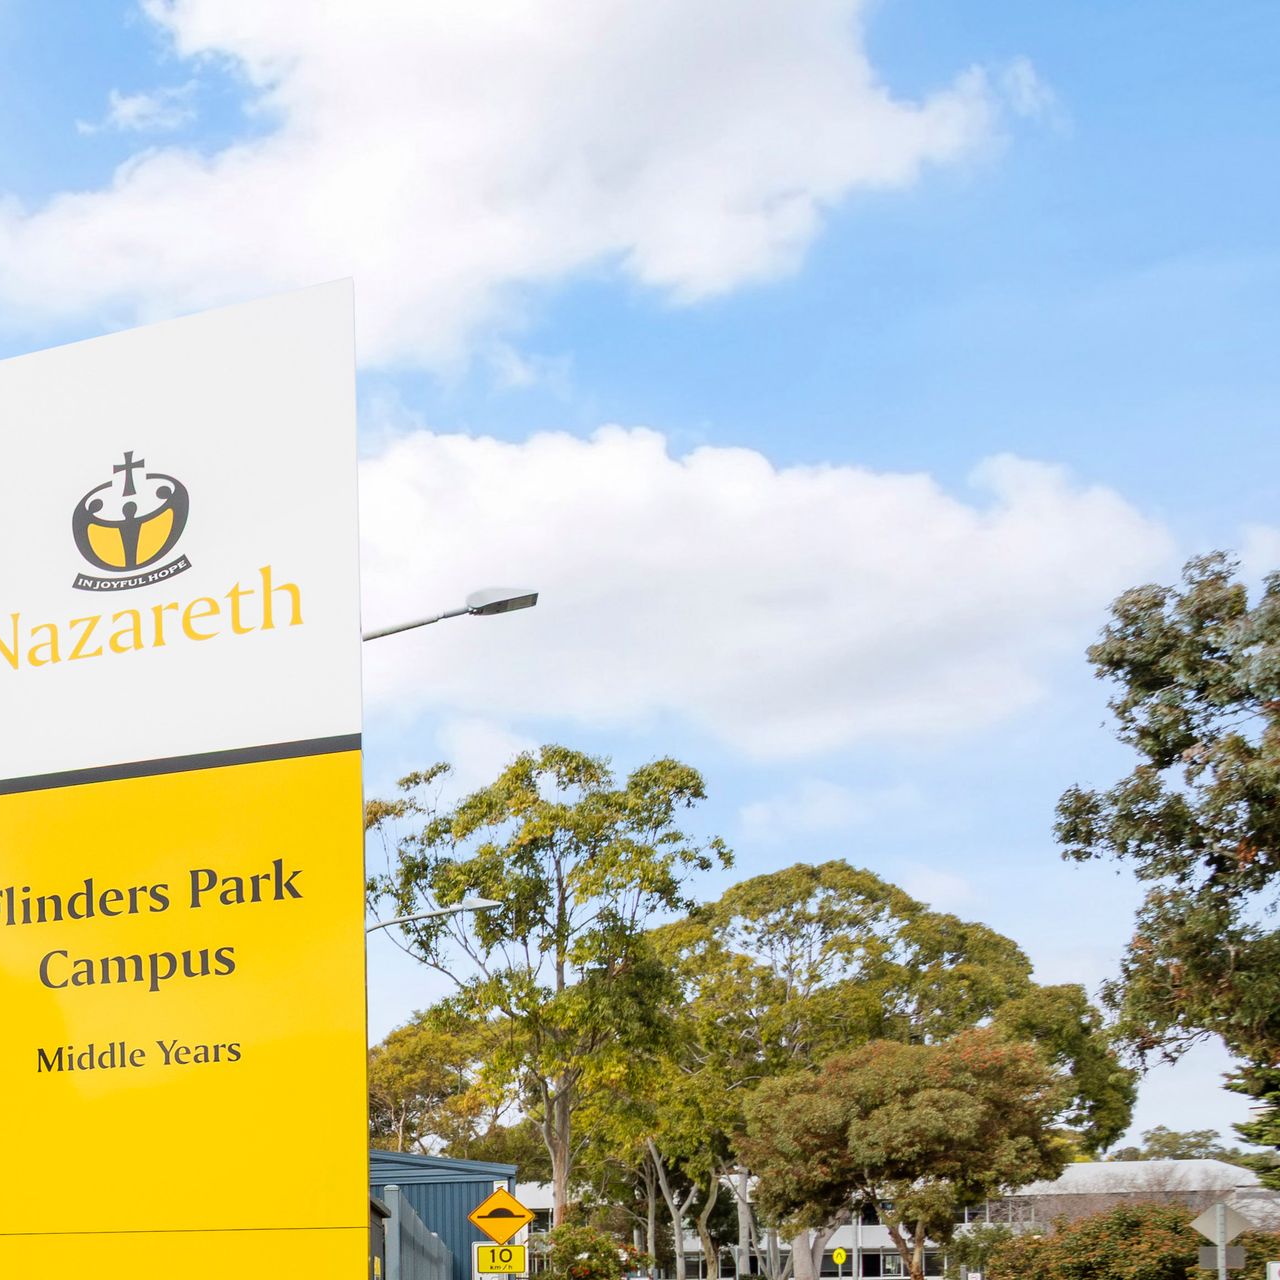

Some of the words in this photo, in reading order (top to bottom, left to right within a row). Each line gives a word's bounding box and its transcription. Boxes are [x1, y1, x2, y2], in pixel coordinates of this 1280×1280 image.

[78, 578, 92, 588] IN
[93, 578, 146, 590] JOYFUL
[148, 559, 187, 582] HOPE
[189, 858, 304, 908] Park
[39, 945, 236, 992] Campus
[37, 1042, 146, 1073] Middle
[155, 1039, 242, 1066] Years
[490, 1248, 513, 1263] 10
